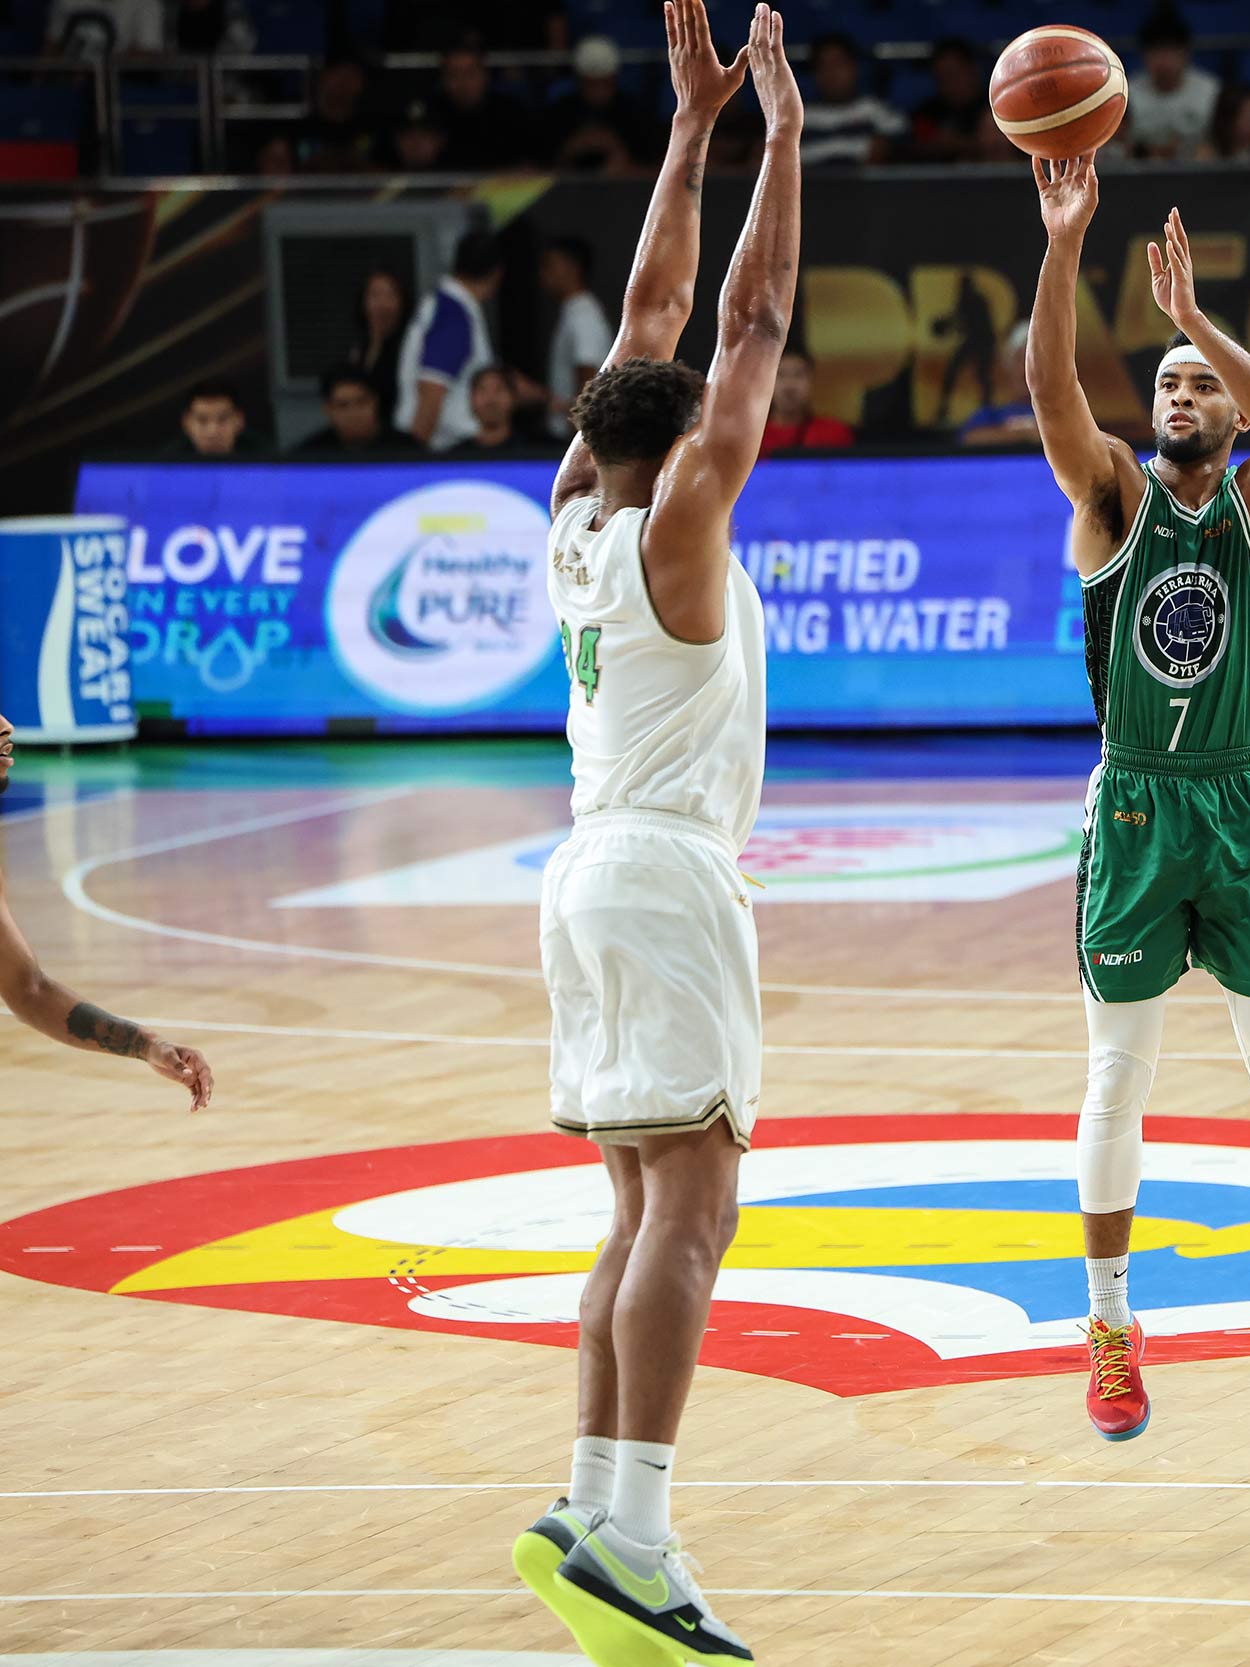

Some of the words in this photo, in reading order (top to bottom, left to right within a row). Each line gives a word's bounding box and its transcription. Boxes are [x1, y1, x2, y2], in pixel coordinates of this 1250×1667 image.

[127, 525, 307, 584] LOVE
[731, 539, 921, 594] URIFIED
[74, 535, 110, 706] SWEAT
[176, 589, 297, 616] EVERY
[417, 587, 529, 635] PURE
[842, 598, 1011, 653] WATER
[1167, 697, 1191, 752] 7
